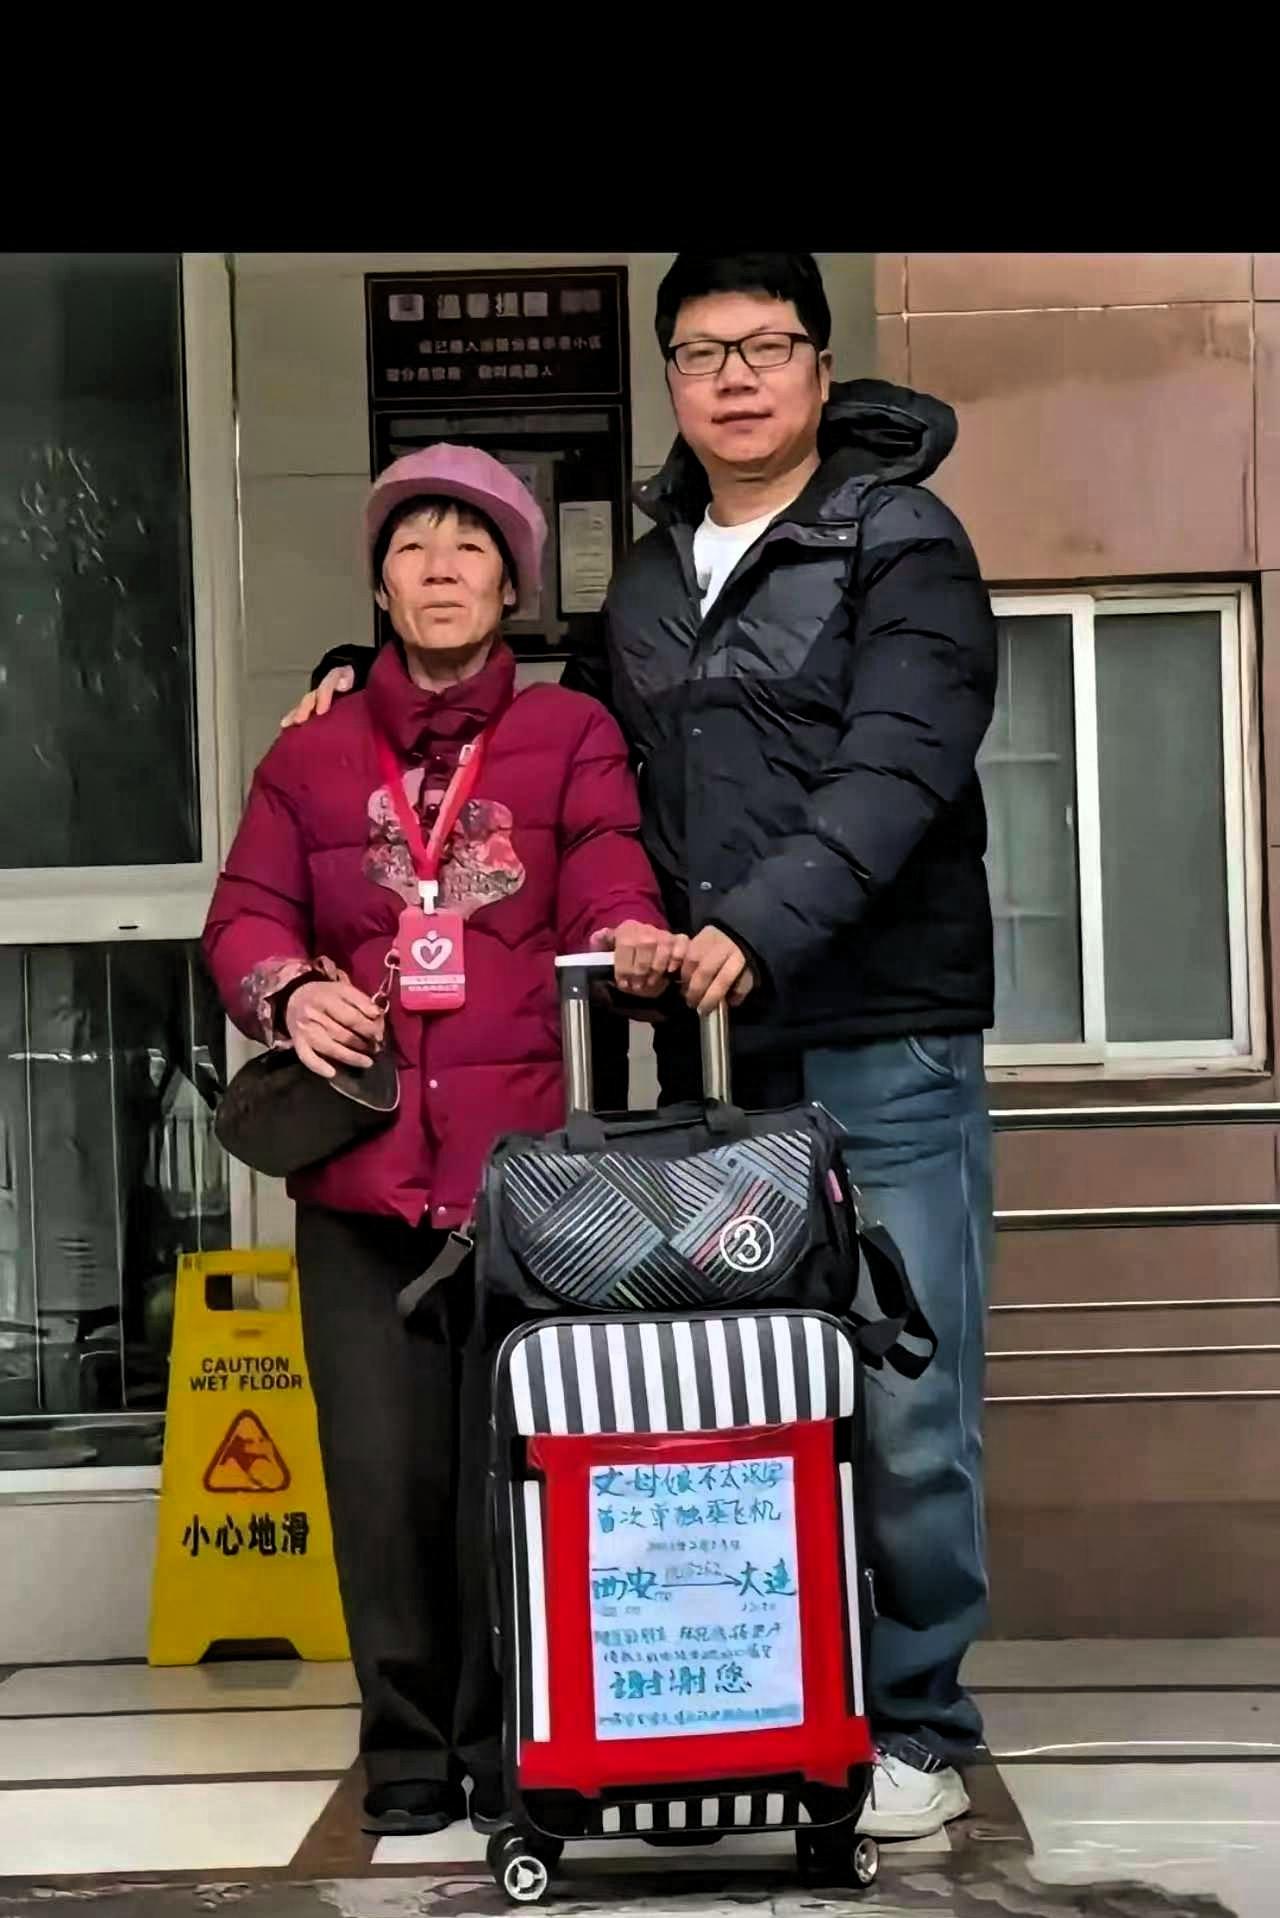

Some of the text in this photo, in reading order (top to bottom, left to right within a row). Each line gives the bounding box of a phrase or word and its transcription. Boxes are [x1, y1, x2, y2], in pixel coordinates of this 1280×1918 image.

[202, 1356, 290, 1374] CAUTION
[190, 1373, 303, 1391] WET FLOOR
[181, 1511, 311, 1557] 小心地滑
[592, 1566, 658, 1601] 西安
